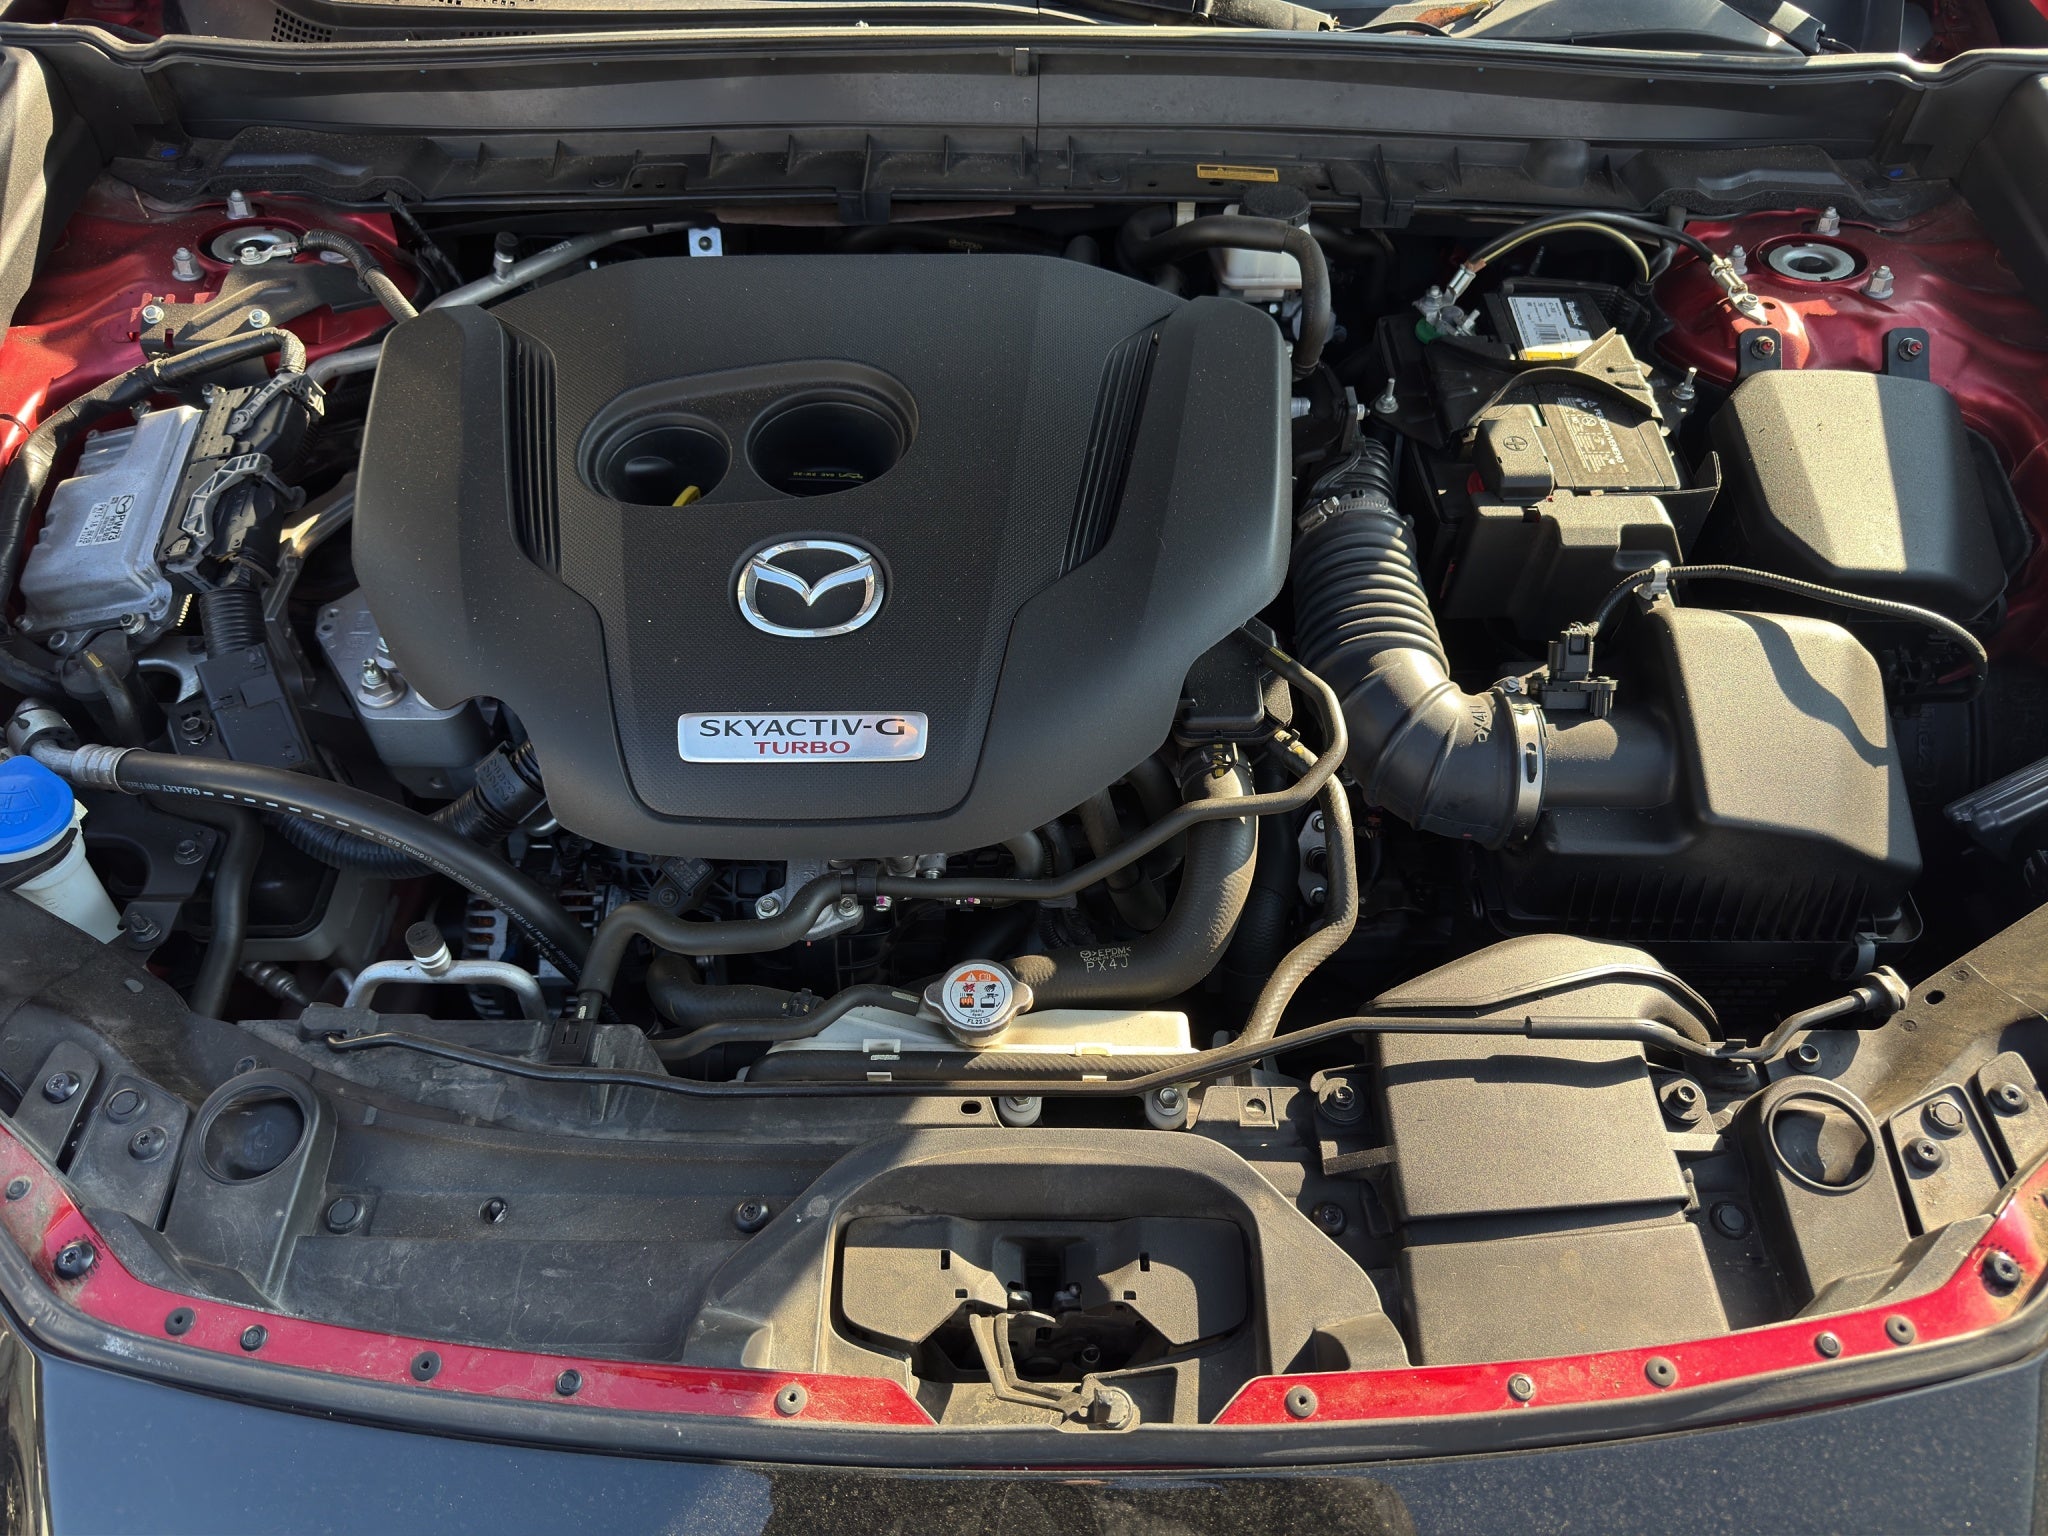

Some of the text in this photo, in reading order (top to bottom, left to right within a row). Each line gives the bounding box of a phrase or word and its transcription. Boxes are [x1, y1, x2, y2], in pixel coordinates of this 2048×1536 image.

[699, 718, 906, 737] SKYACTIV-G
[754, 740, 851, 755] TURBO
[163, 784, 201, 796] GALAXY
[432, 860, 457, 876] HOSE
[456, 874, 492, 900] SUCTION
